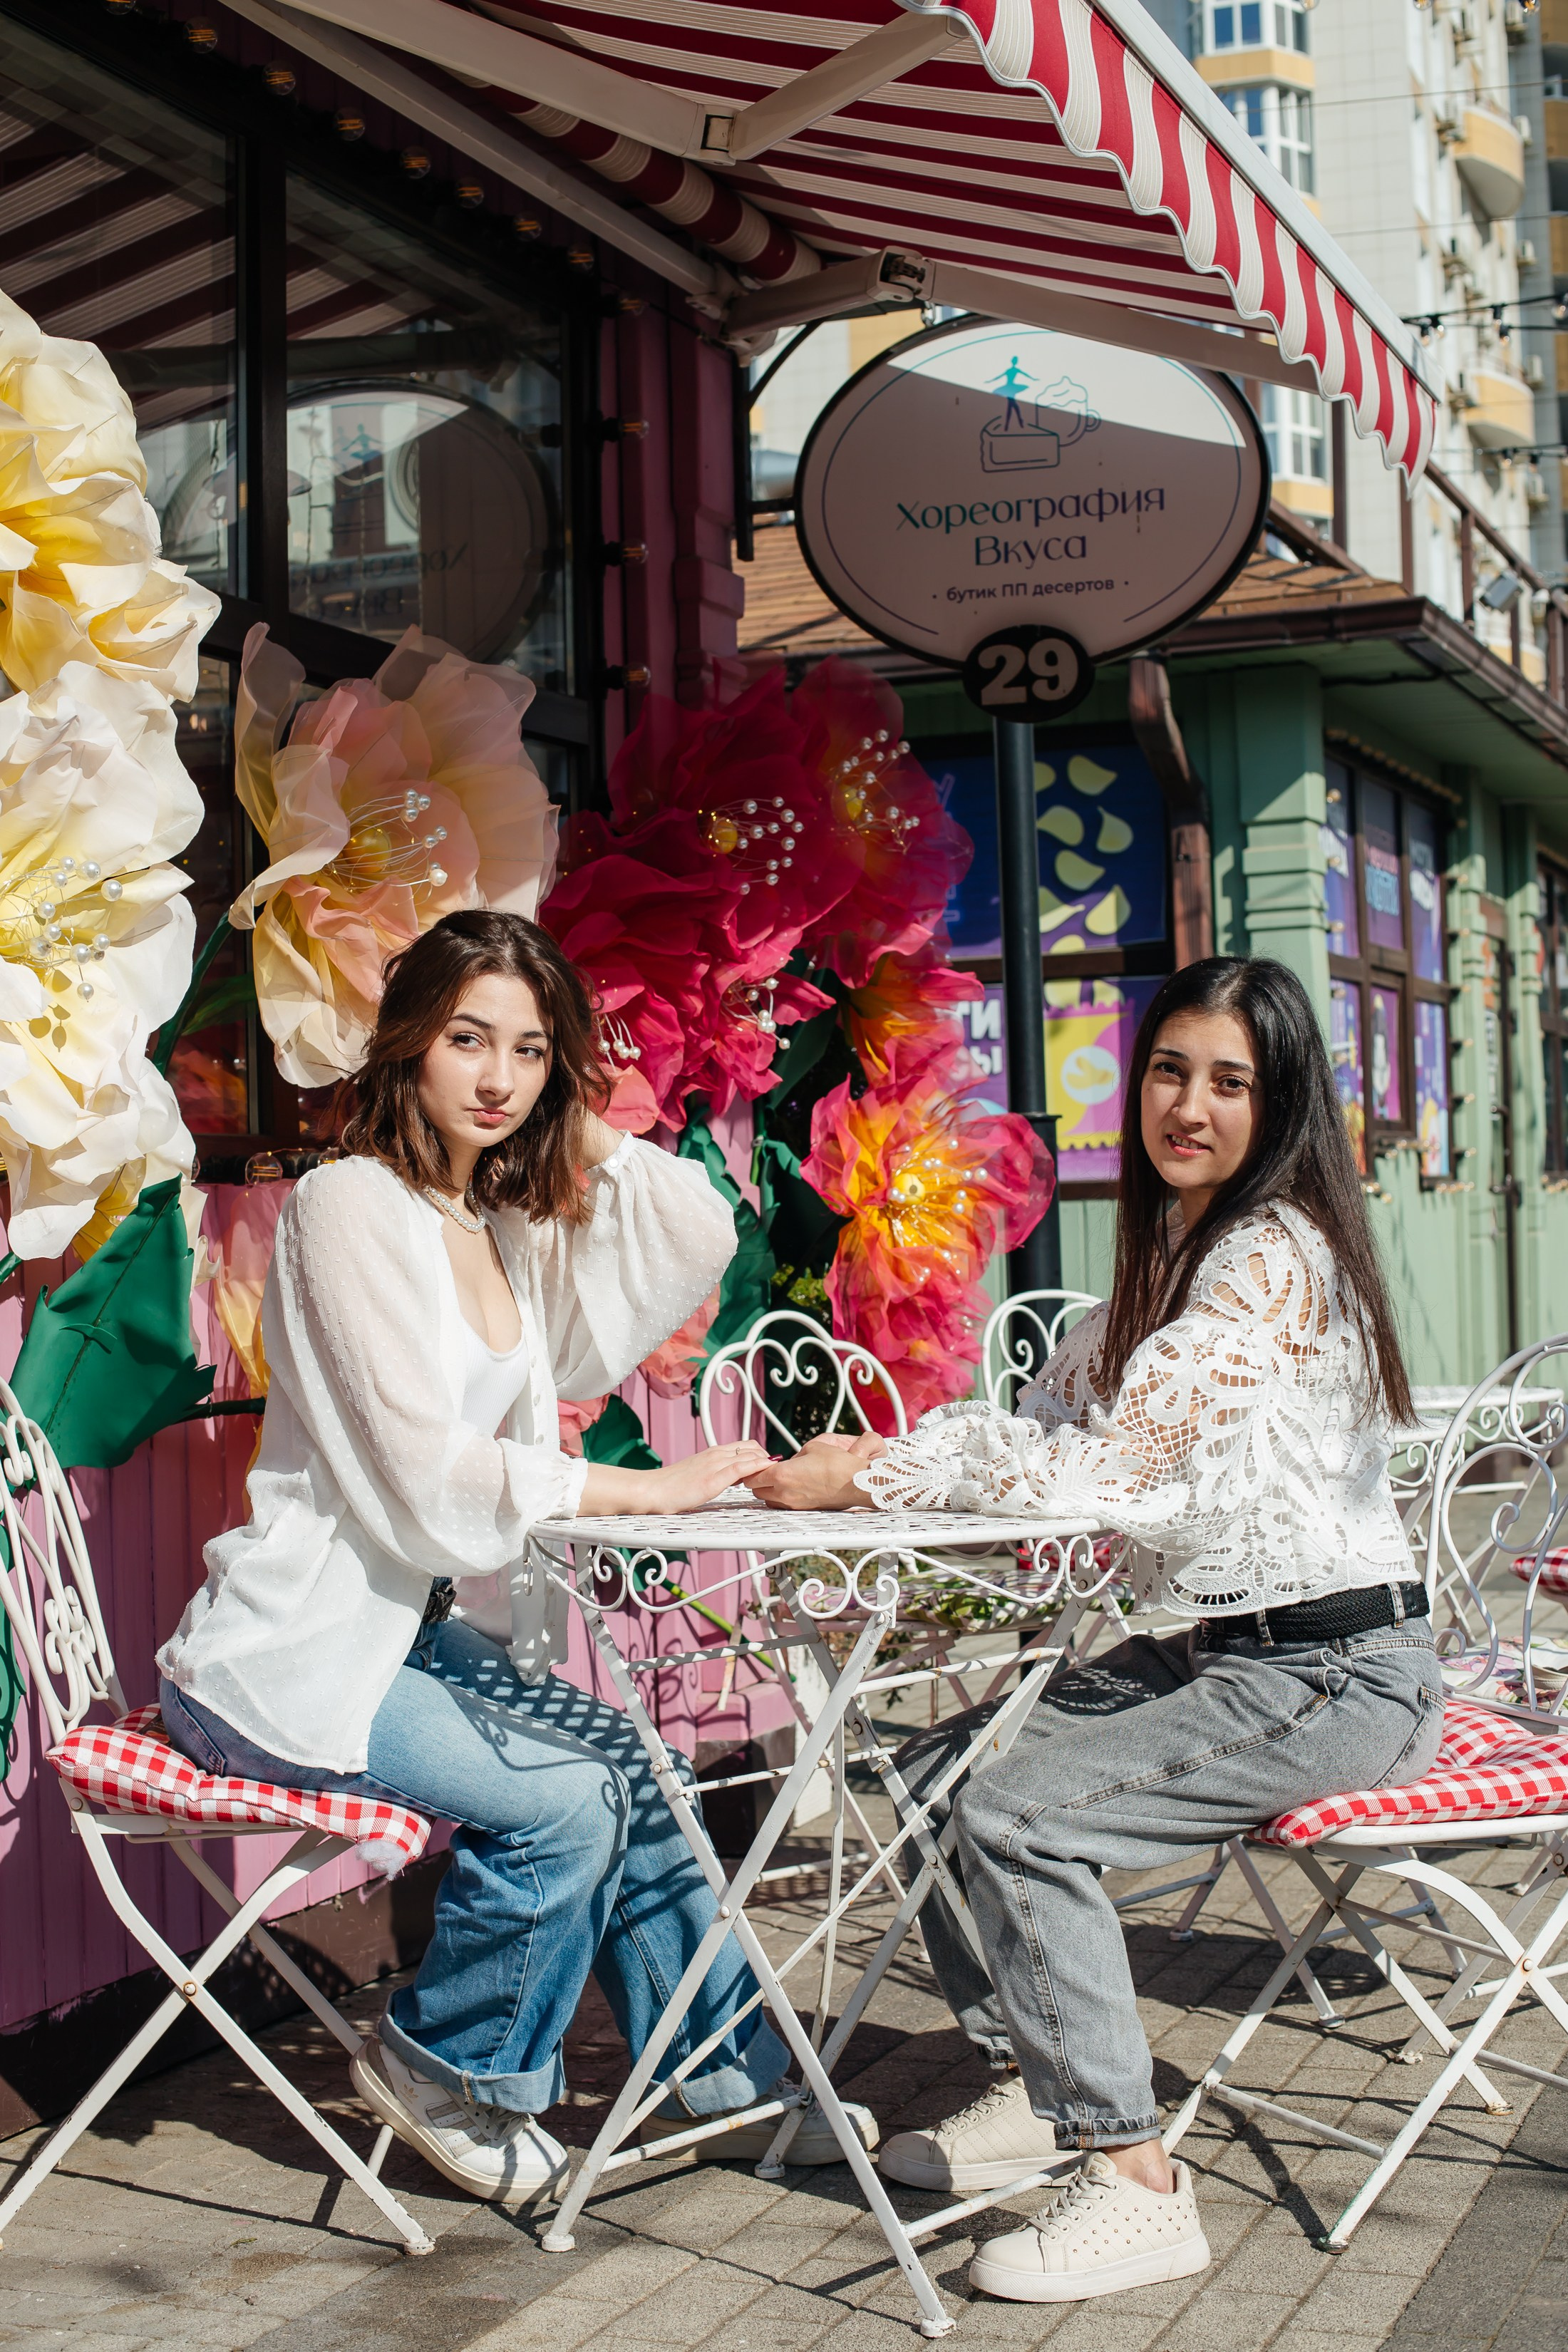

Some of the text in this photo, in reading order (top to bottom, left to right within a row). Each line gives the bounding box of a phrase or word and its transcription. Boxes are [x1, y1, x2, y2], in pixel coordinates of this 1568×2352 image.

[896, 488, 1165, 535] Хореография
[974, 535, 1087, 569] Вкуса
[947, 579, 1115, 604] бутик ПП десертов
[978, 638, 1079, 706] 29
